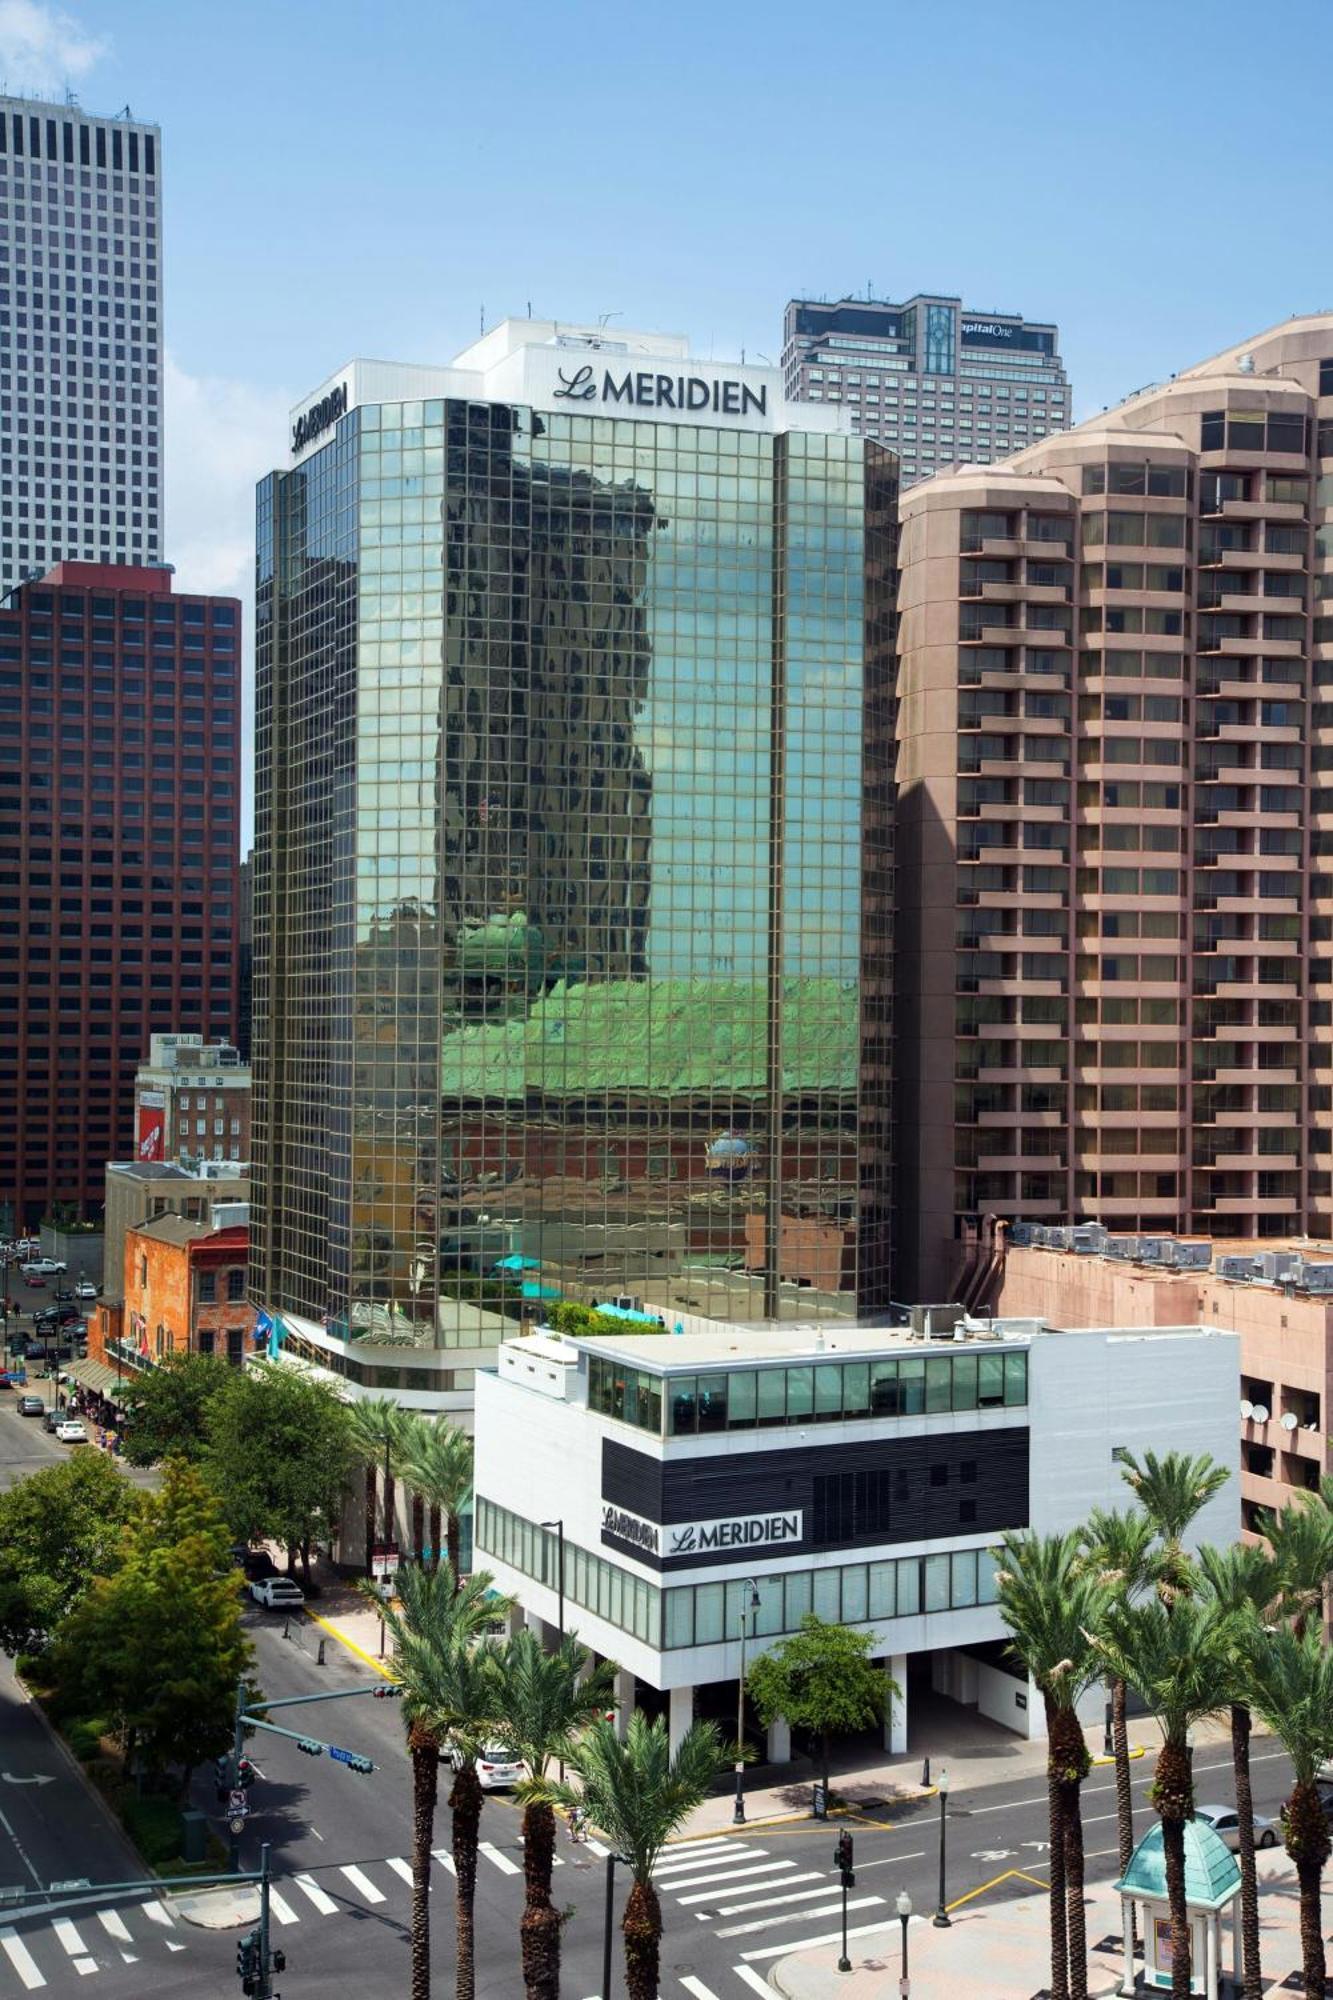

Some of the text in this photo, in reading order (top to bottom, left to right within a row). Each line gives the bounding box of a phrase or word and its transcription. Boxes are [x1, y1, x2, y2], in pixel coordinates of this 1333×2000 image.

[553, 365, 766, 416] Le MERIDIEN
[670, 1516, 798, 1553] Le MERIDIEN
